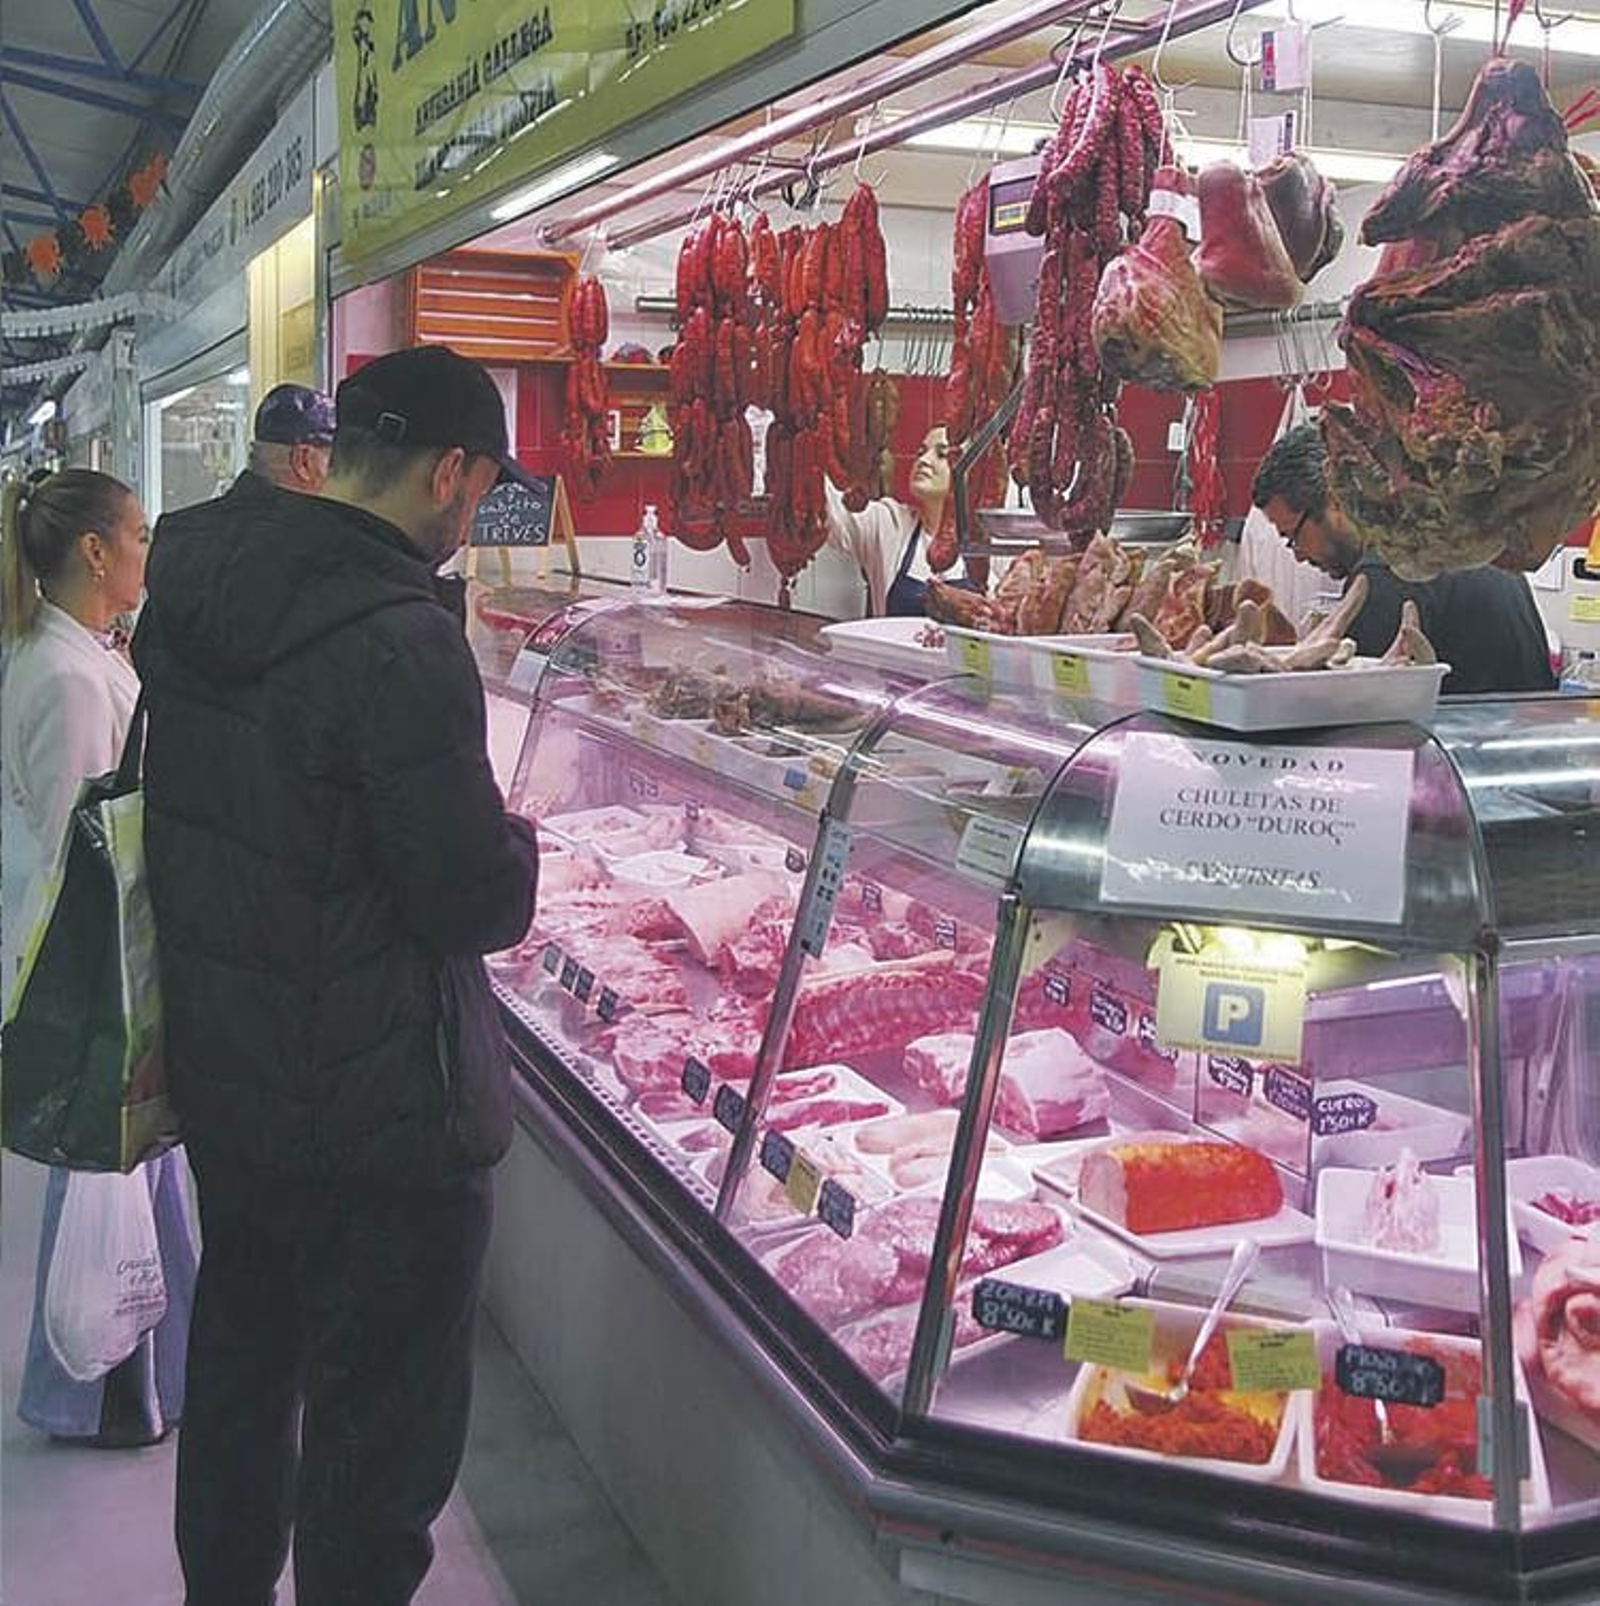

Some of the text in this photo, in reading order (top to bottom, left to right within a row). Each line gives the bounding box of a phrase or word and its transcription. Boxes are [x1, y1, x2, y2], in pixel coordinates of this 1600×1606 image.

[482, 5, 553, 85] GALLEGA
[1177, 787, 1345, 814] CHULETAS DE
[1159, 808, 1242, 830] CERDO
